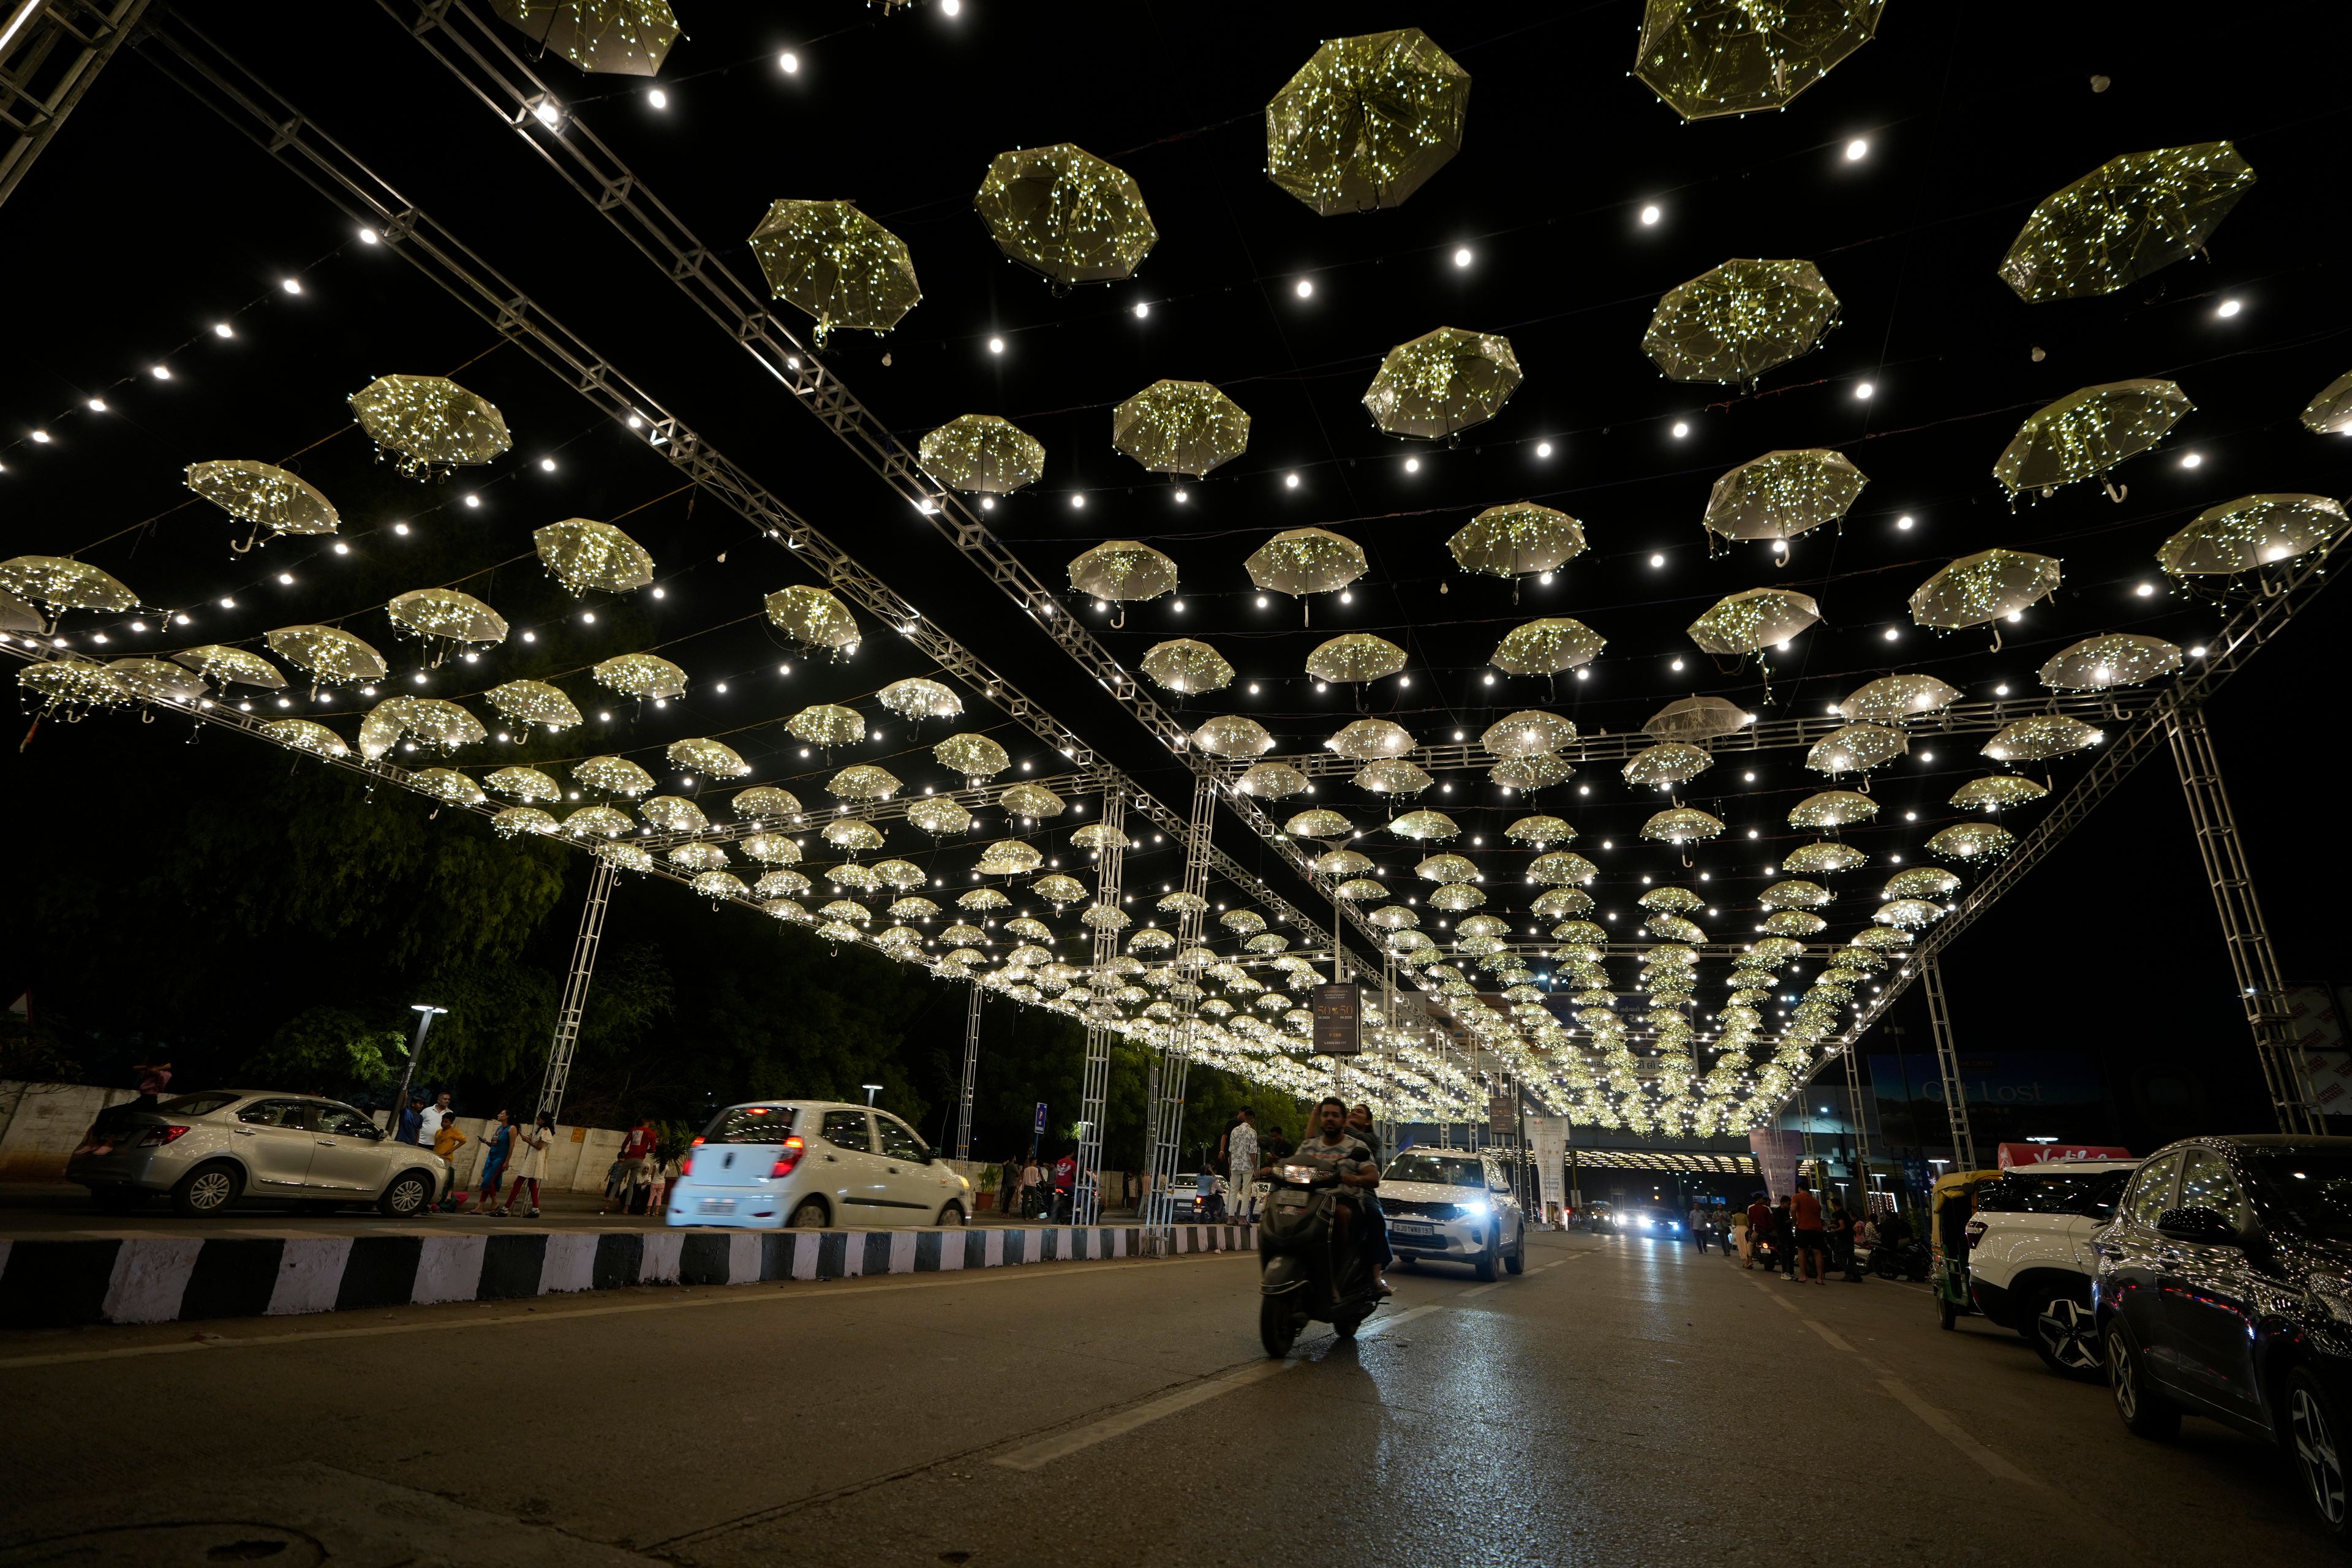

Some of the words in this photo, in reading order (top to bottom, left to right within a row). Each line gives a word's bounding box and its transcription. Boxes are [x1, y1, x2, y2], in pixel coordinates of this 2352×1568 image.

[1318, 1005, 1331, 1016] 50
[1340, 1005, 1353, 1016] 50
[1980, 1080, 2044, 1102] Lost
